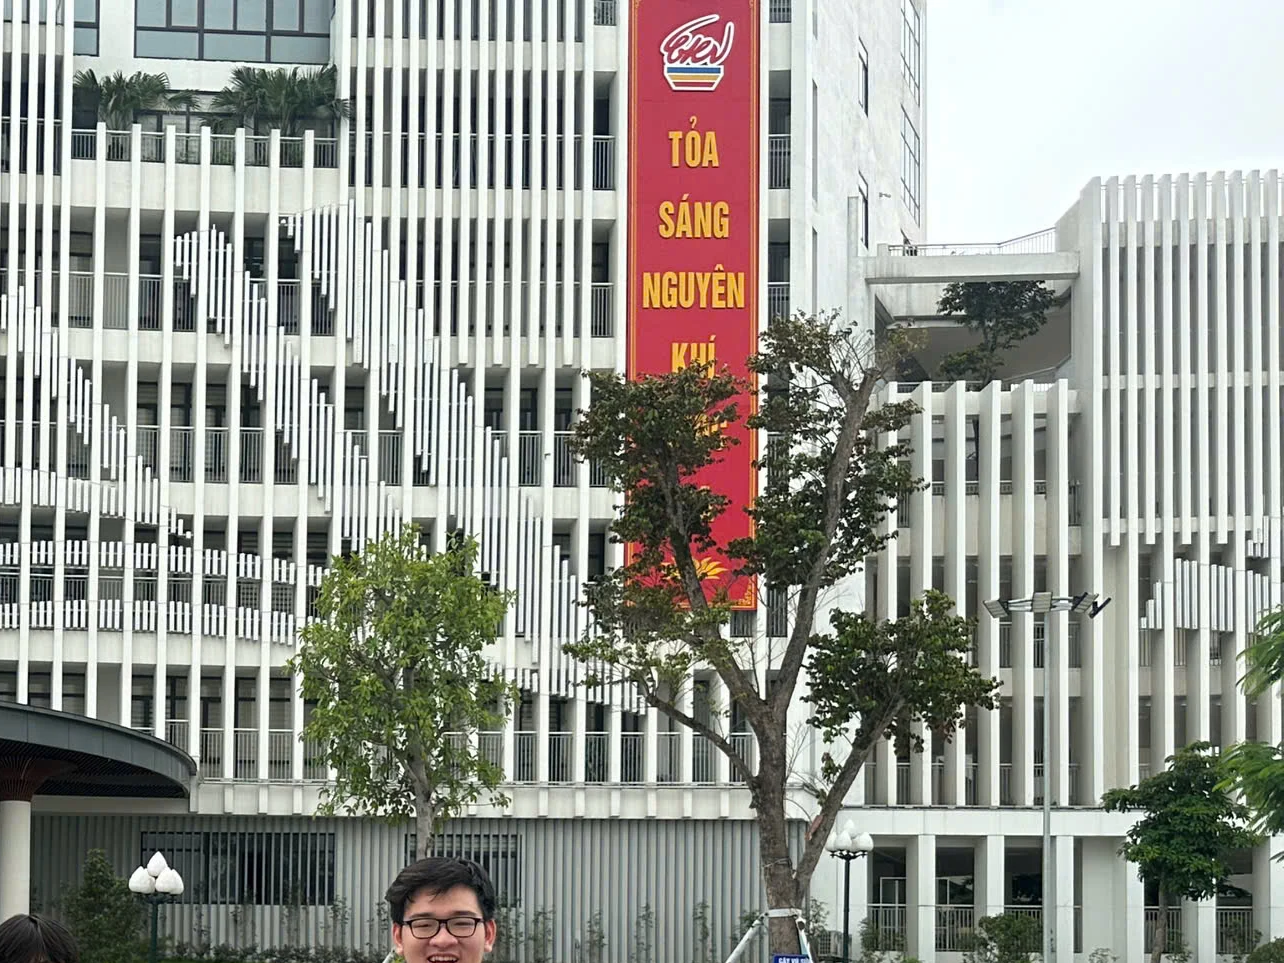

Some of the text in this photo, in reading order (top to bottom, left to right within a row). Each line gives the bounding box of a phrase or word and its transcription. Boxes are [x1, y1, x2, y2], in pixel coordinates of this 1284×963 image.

[669, 116, 720, 168] TỎA
[659, 195, 730, 239] SÁNG
[643, 264, 745, 309] NGUYÊN
